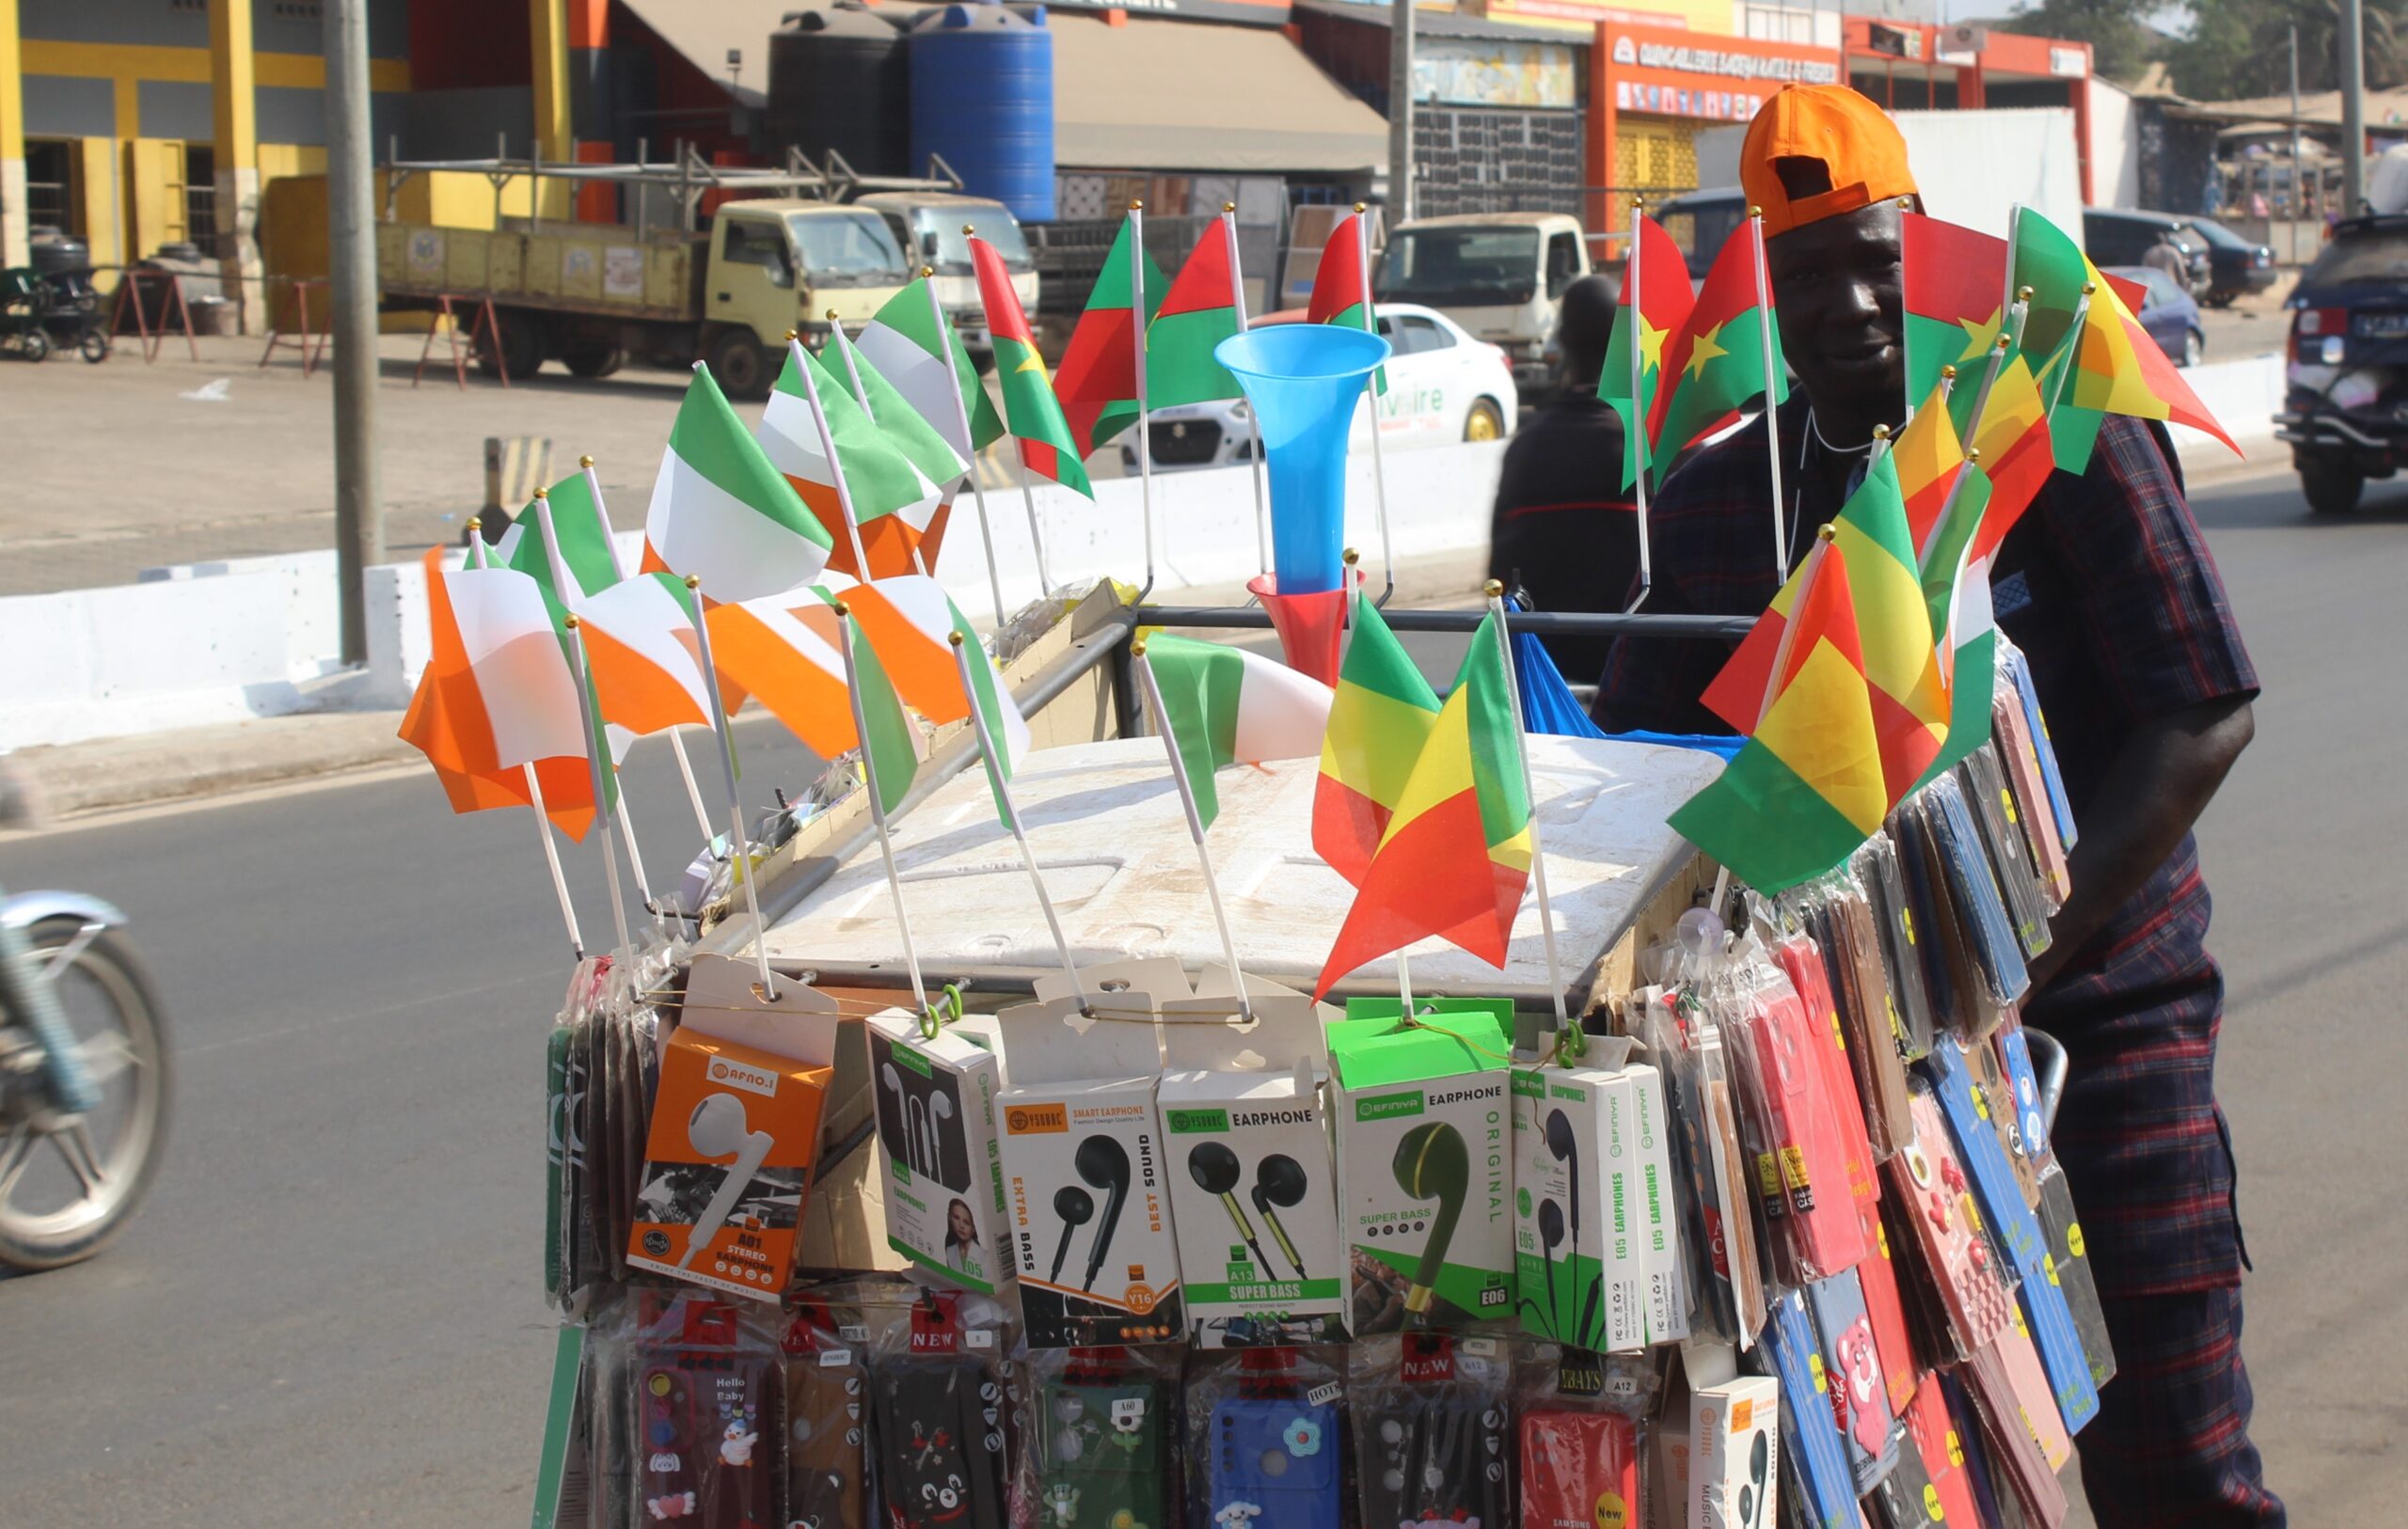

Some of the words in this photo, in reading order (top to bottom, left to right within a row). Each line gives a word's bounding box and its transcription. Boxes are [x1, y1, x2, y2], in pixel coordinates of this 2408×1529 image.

[1429, 1085, 1502, 1107] EARPHONE
[1073, 1107, 1101, 1119] SMART
[1101, 1105, 1145, 1116] EARPHONE
[1232, 1109, 1313, 1127] EARPHONE
[1138, 1134, 1155, 1188] SOUND
[1485, 1111, 1502, 1223] ORIGINAL
[1644, 1163, 1661, 1224] EARPHONES
[1612, 1172, 1626, 1234] EARPHONES
[1797, 1197, 1814, 1209] CAS
[1147, 1193, 1161, 1232] BEST
[1359, 1211, 1398, 1225] SUPER
[1401, 1207, 1431, 1221] BASS
[1012, 1176, 1029, 1226] EXTRA
[1021, 1232, 1035, 1270] BASS
[1615, 1237, 1627, 1260] E05
[1652, 1229, 1665, 1252] E05
[726, 1244, 768, 1262] STEREO
[715, 1252, 775, 1273] EARPHONE
[1230, 1270, 1255, 1281] A13
[1129, 1293, 1151, 1305] Y16
[1229, 1285, 1268, 1300] SUPER
[1270, 1284, 1301, 1298] BASS
[1481, 1288, 1506, 1305] E06
[912, 1332, 953, 1347] NEW
[1404, 1360, 1450, 1376] NEW
[717, 1378, 746, 1388] Hello
[1613, 1381, 1631, 1392] A12
[717, 1392, 744, 1402] Baby
[1701, 1484, 1712, 1523] MUSIC
[1598, 1506, 1623, 1520] New
[1553, 1519, 1591, 1529] SAMSUNG
